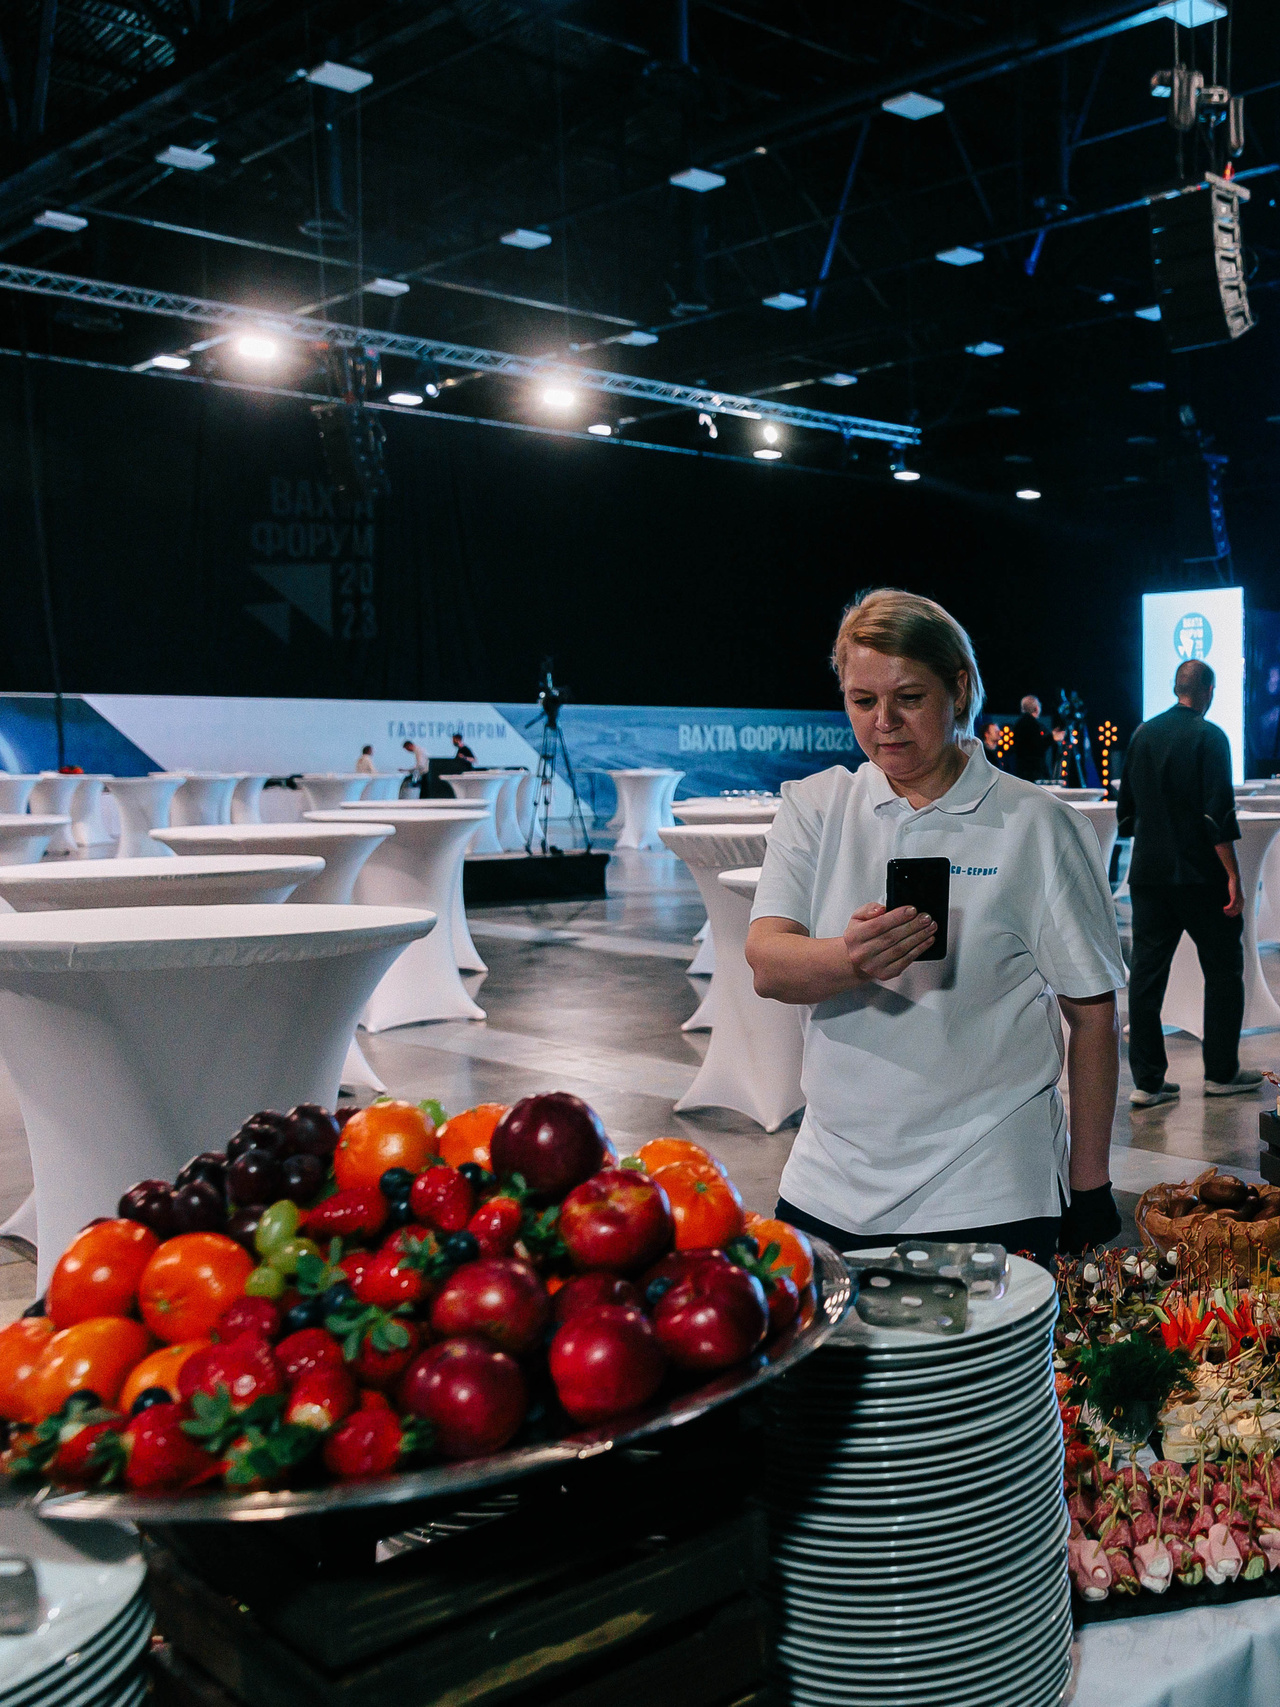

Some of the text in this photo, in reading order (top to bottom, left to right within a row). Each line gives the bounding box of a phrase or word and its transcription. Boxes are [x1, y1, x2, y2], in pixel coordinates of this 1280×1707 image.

[270, 476, 374, 519] ВАХА
[251, 520, 375, 558] ФОРУМ
[339, 562, 374, 594] 20
[341, 600, 378, 640] 23
[387, 719, 506, 738] ГАЗСТРОЙПРОМ
[679, 724, 738, 752] ВАХТА
[739, 725, 804, 753] ФОРУМ
[815, 726, 854, 751] 2023
